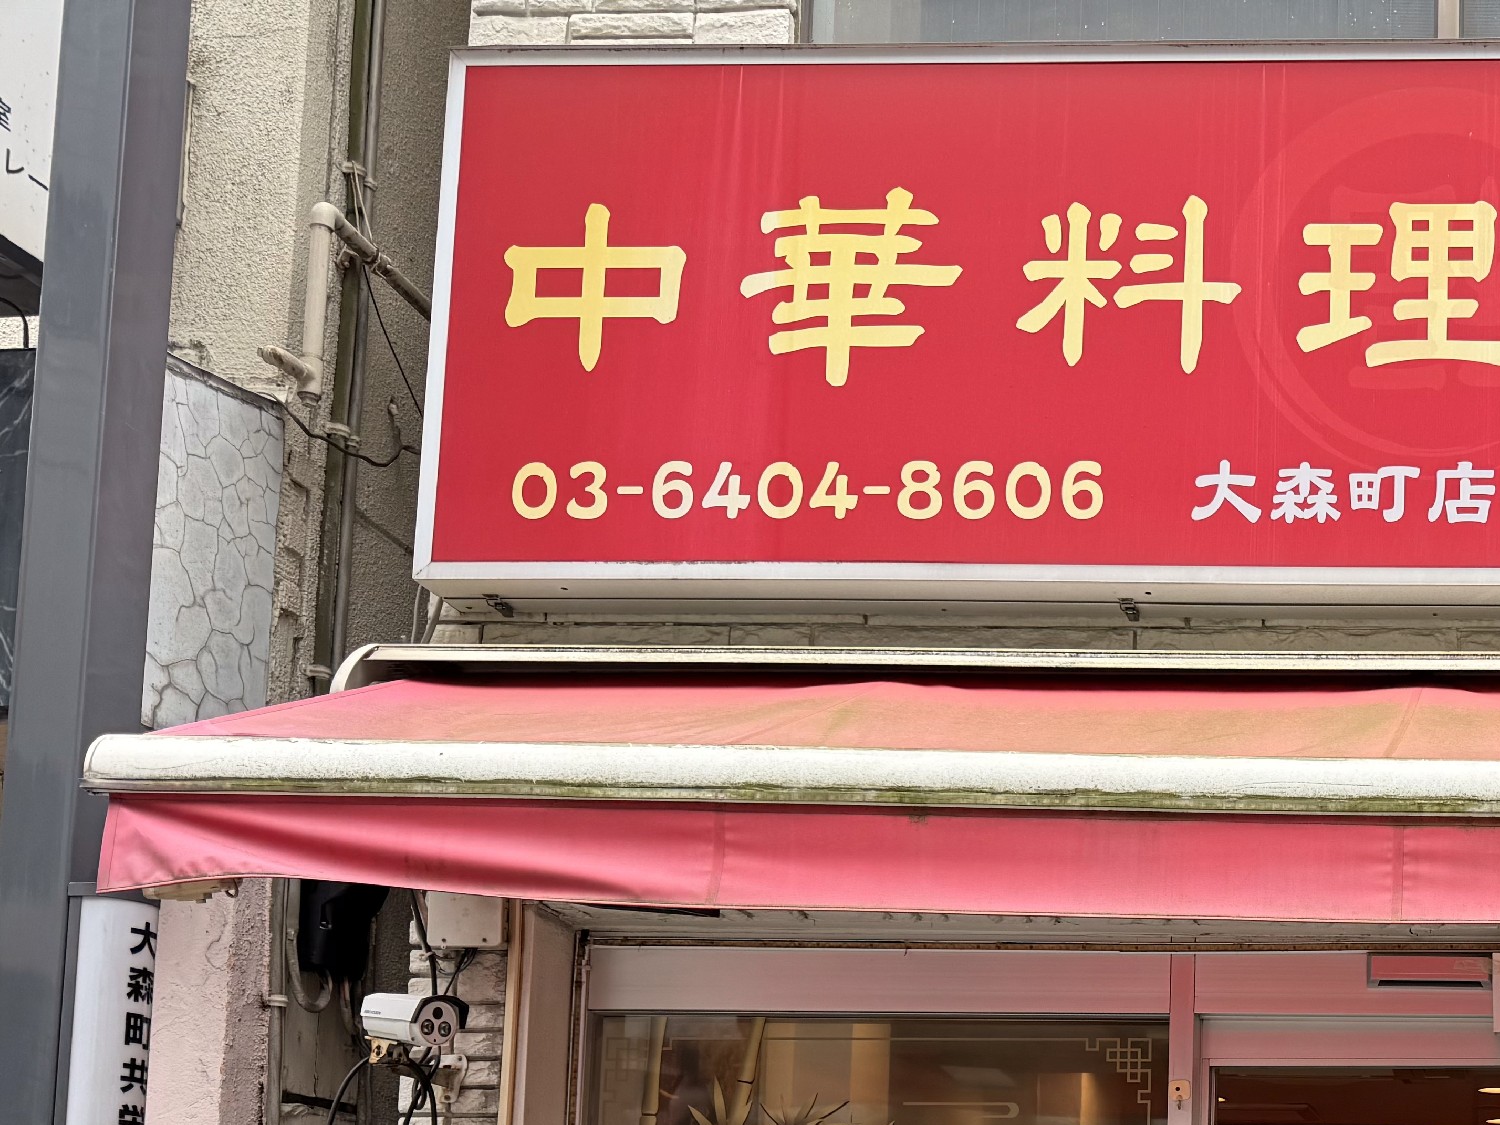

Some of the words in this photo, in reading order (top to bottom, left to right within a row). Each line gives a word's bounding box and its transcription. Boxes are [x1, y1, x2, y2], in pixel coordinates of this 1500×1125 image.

[511, 459, 1105, 520] 03-6404-8606
[1189, 458, 1496, 525] 大森町店
